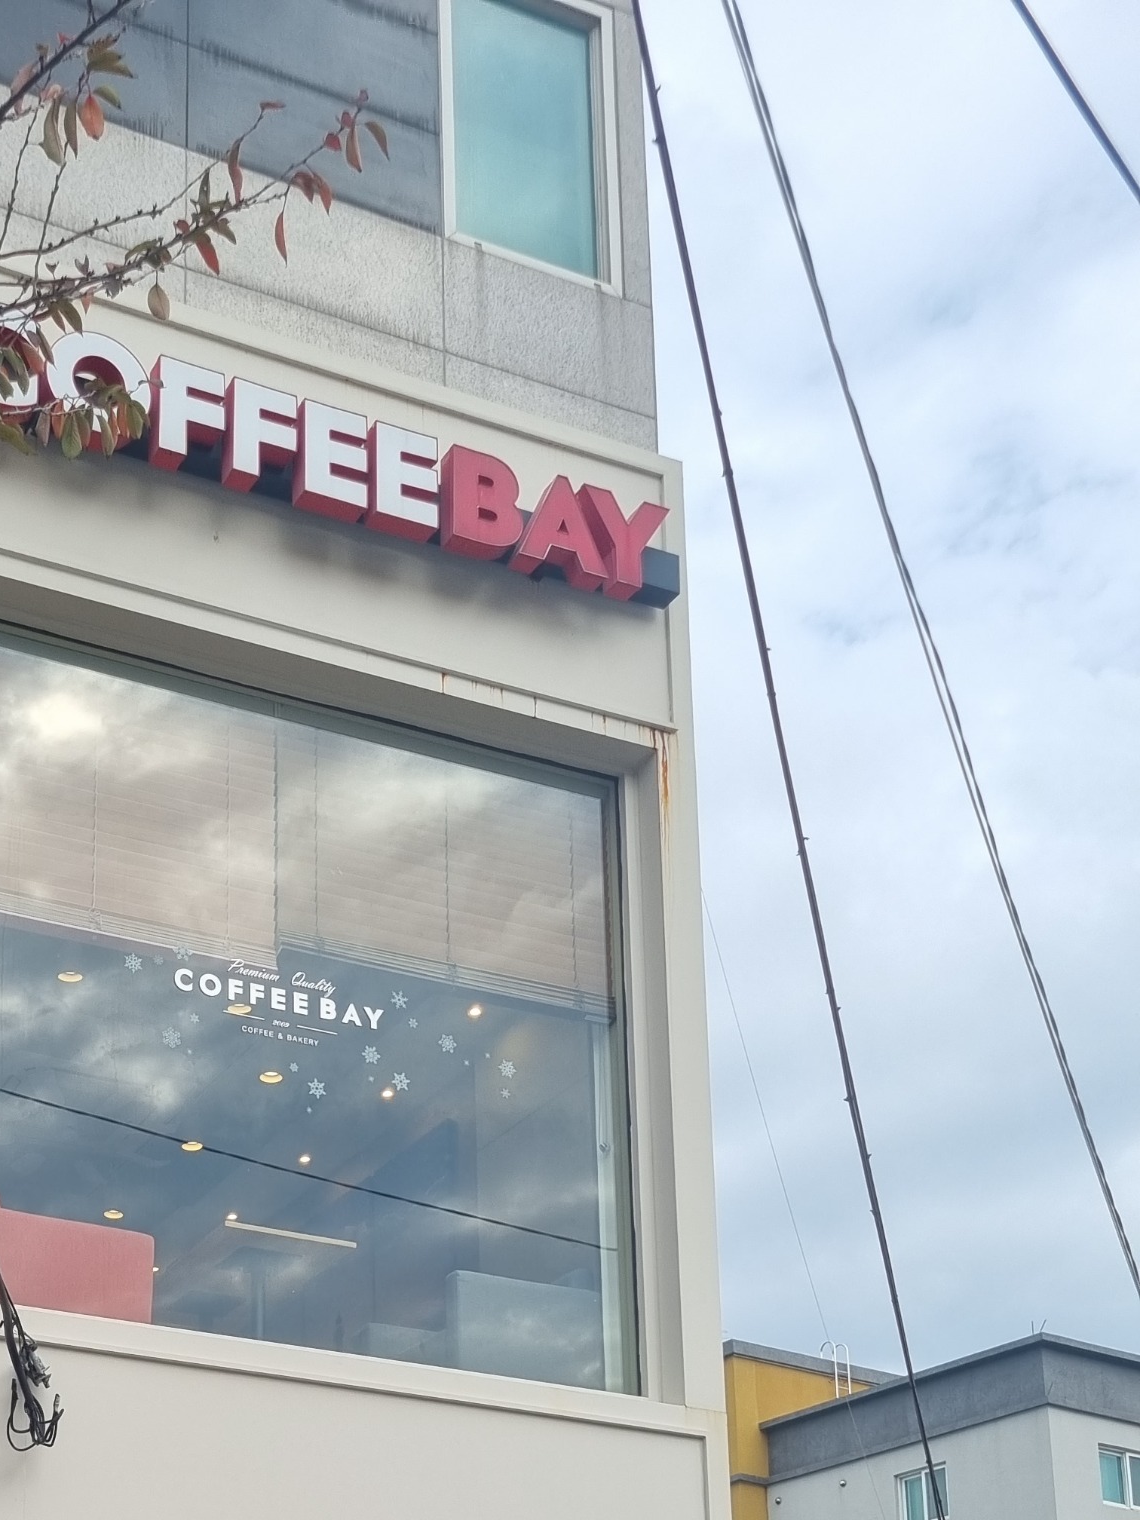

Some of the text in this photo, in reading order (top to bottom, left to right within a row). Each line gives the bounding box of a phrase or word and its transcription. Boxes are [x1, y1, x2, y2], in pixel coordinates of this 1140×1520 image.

[227, 959, 337, 998] Premium Quality
[241, 1025, 319, 1047] COFFEE & BAKERY
